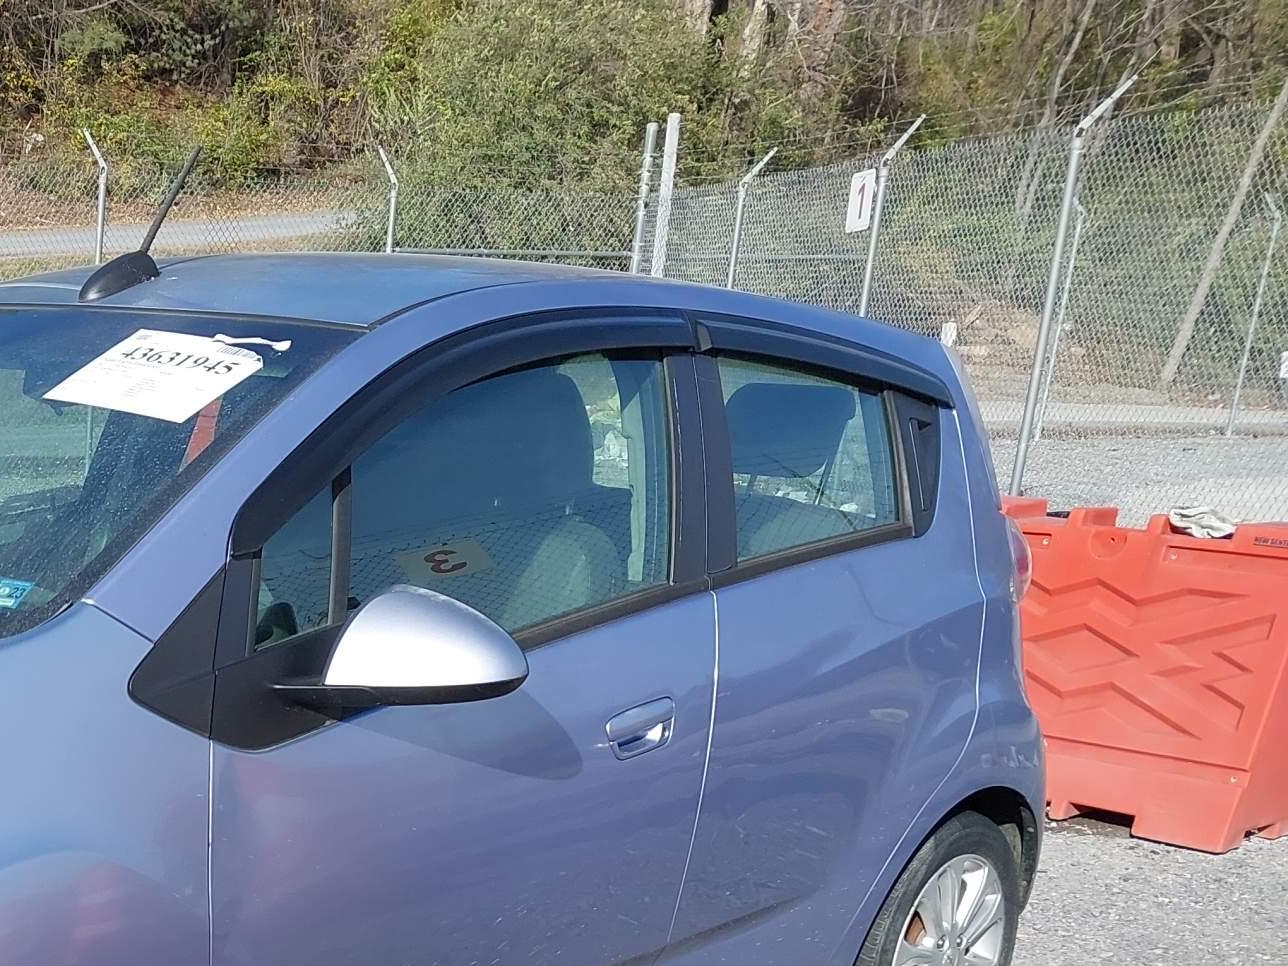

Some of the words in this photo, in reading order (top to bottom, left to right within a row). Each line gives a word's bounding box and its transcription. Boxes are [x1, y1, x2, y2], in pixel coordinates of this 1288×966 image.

[858, 182, 866, 220] 1
[121, 346, 241, 375] 43631945
[7, 586, 27, 599] 23
